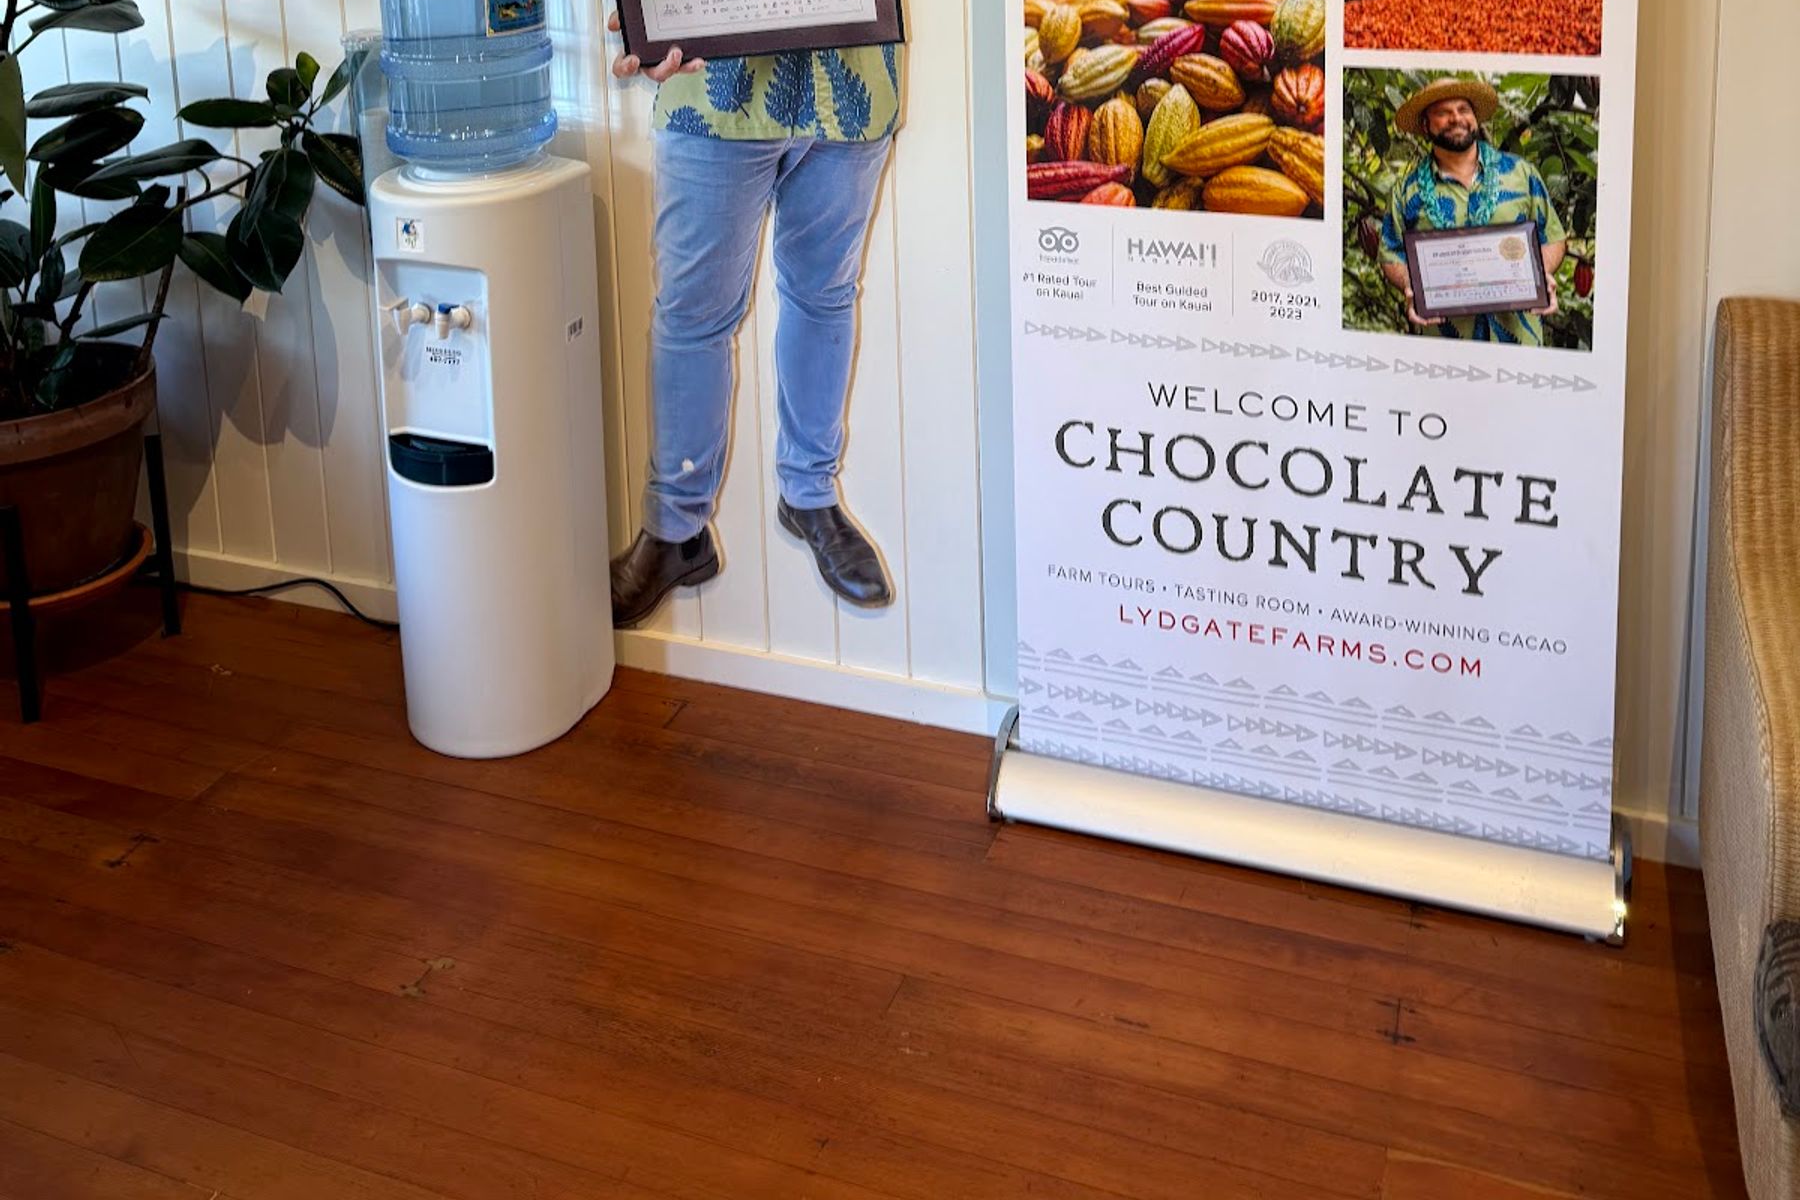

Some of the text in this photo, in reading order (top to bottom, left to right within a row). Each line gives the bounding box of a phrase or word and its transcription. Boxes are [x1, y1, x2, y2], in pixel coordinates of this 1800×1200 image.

[1038, 273, 1070, 286] Rated
[1073, 276, 1097, 288] Tour
[1136, 281, 1208, 298] Best Guided
[1036, 287, 1084, 300] on Kauai
[1133, 294, 1212, 312] Tour on Kauai
[1251, 290, 1320, 309] 2017, 2021,
[1270, 306, 1302, 321] 2023
[1147, 381, 1448, 441] WELCOME TO
[1054, 420, 1559, 529] CHOCOLATE
[1101, 498, 1503, 598] COUNTRY
[1048, 564, 1567, 654] FARM TOURS TASTING ROOM AWARD-WINNING CACAO
[1119, 603, 1482, 678] LYDGATEFARMS.COM
